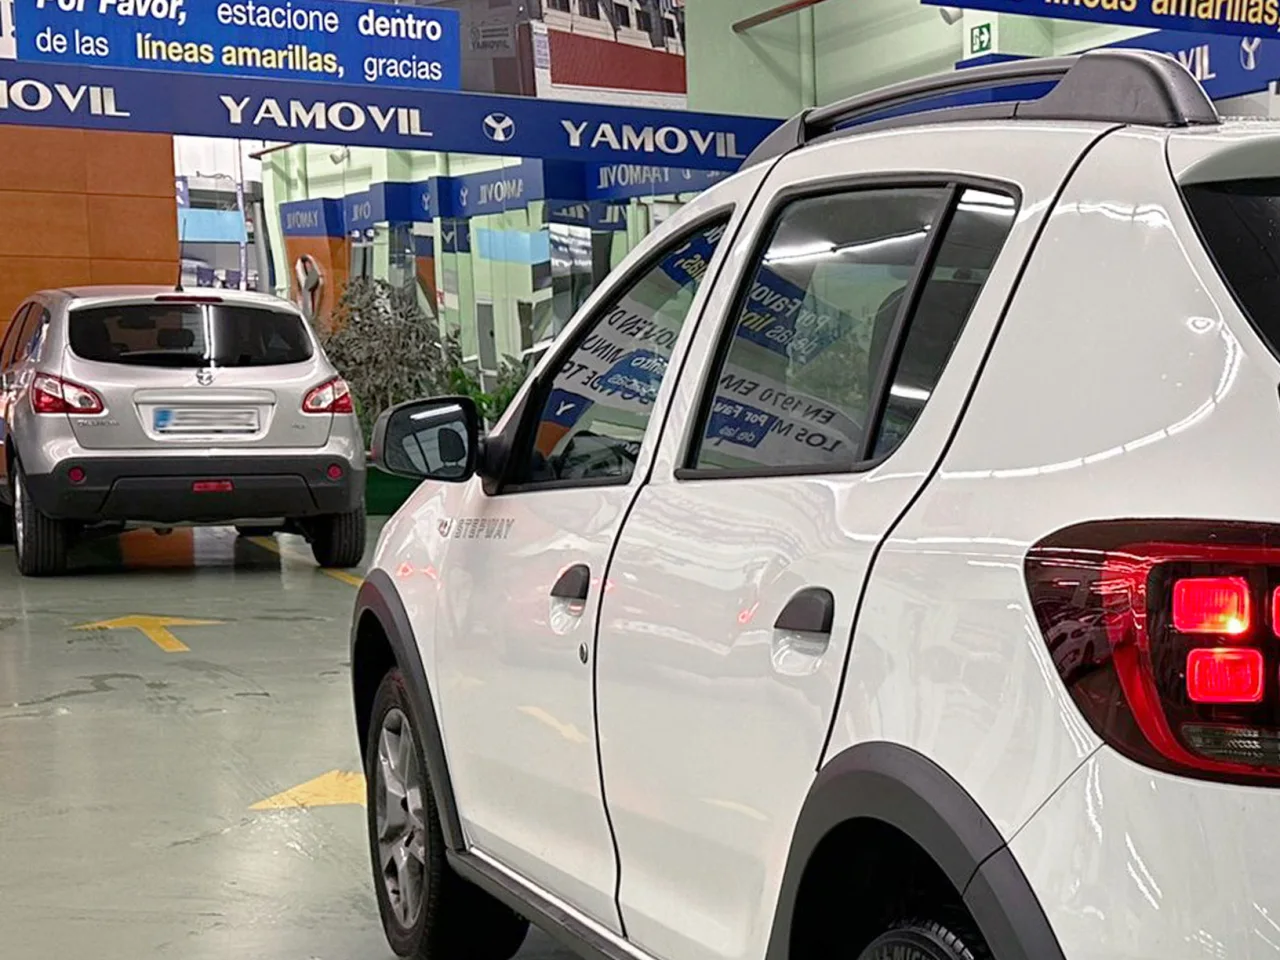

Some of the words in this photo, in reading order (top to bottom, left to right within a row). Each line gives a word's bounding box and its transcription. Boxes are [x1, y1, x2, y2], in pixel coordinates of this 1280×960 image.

[217, 2, 339, 33] estacione
[358, 9, 442, 41] dentro
[36, 27, 67, 53] de
[75, 29, 109, 56] las
[136, 33, 214, 64] líneas
[222, 45, 344, 77] amarillas,
[364, 55, 442, 82] gracias
[0, 78, 131, 118] OVIL
[220, 95, 433, 137] YAMOVIL
[561, 119, 747, 160] YAMOVIL
